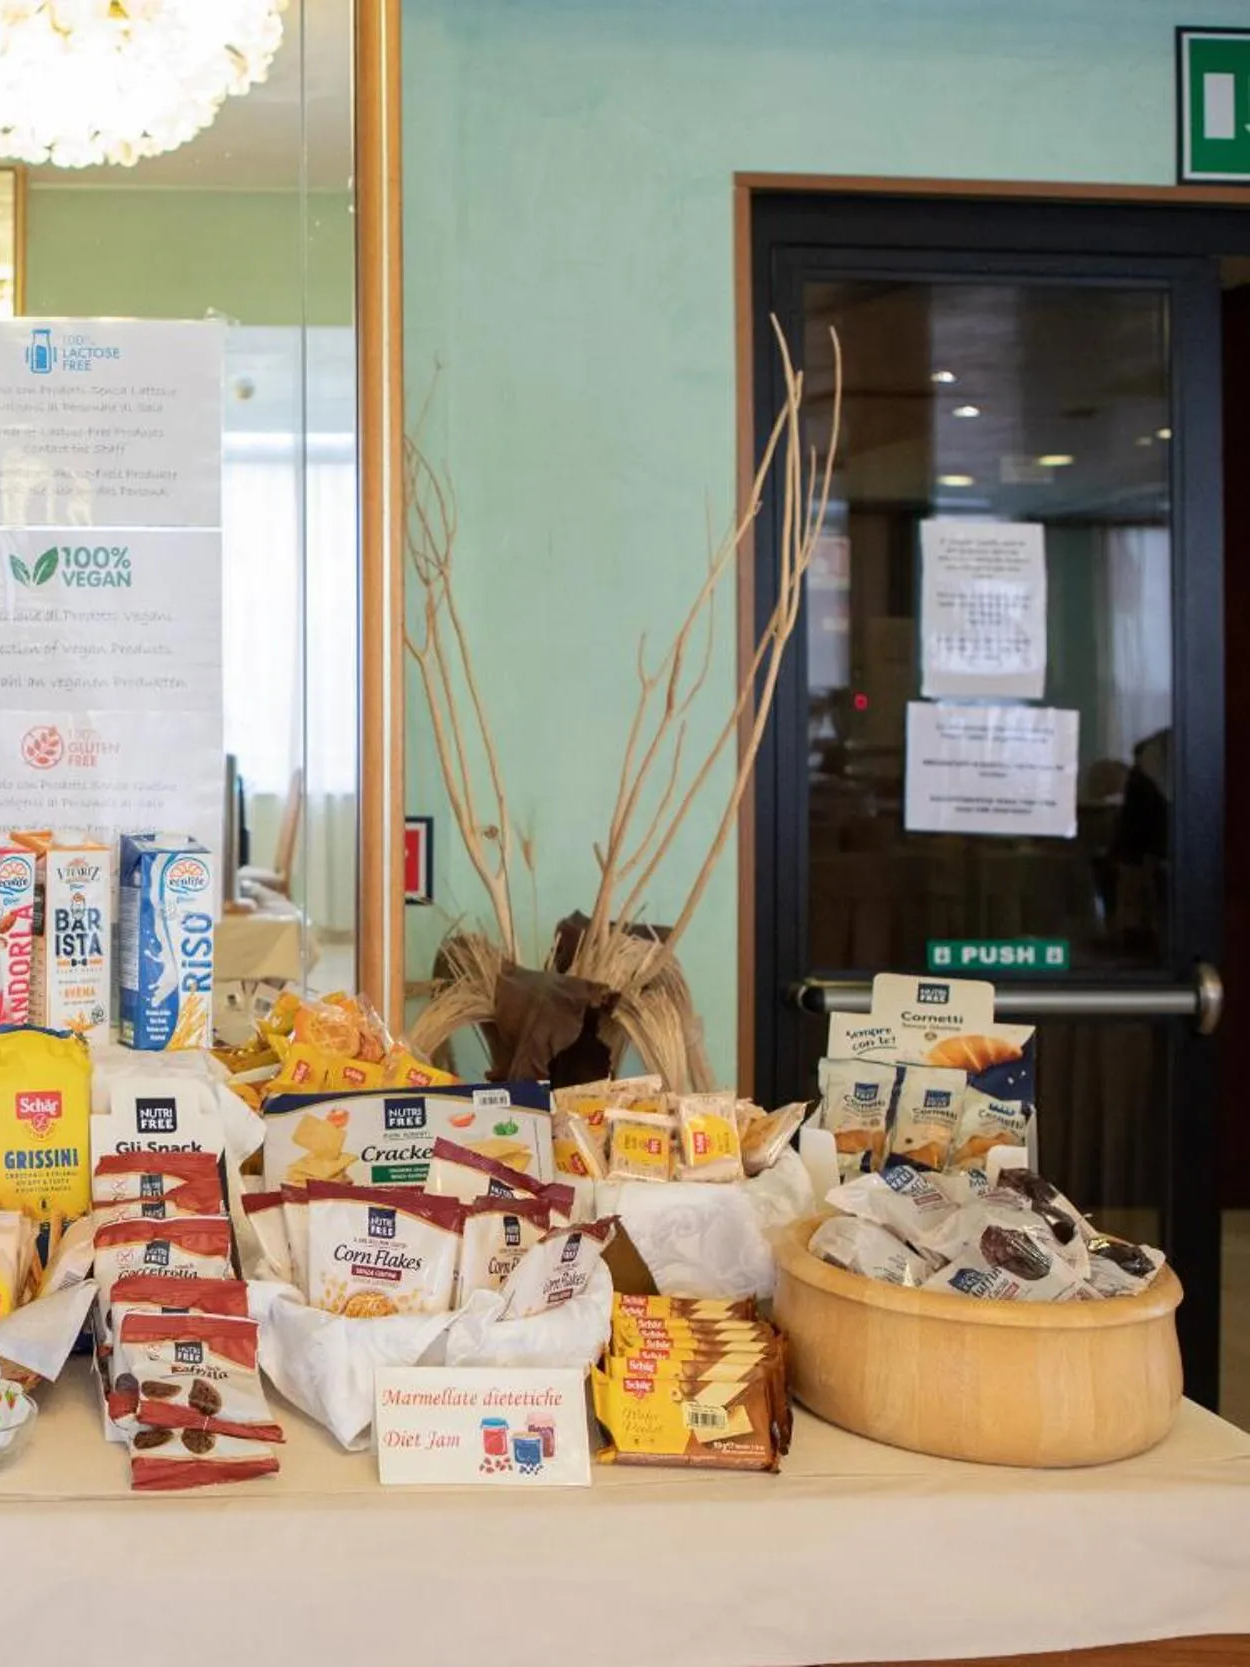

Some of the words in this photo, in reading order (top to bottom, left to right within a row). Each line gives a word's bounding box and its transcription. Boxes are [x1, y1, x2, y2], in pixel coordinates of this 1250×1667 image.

[62, 347, 121, 359] LACTOSE
[62, 360, 93, 372] FREE
[61, 546, 132, 569] 100%
[61, 570, 132, 587] VEGAN
[68, 741, 120, 754] GLUTEN
[68, 755, 98, 767] FREE
[169, 874, 205, 886] ecolife
[55, 933, 103, 957] ISTA
[961, 946, 1036, 965] PUSH
[901, 1010, 964, 1025] Cornetti
[20, 1097, 59, 1115] Schär
[388, 1107, 422, 1117] NUTRI
[140, 1108, 174, 1118] NUTRI
[141, 1119, 174, 1129] FREE
[389, 1117, 423, 1127] FREE
[116, 1141, 142, 1154] Gli
[147, 1141, 203, 1153] Snack
[361, 1145, 434, 1162] Cracke
[4, 1148, 79, 1169] GRISSINI
[370, 1226, 393, 1236] FREE
[146, 1254, 167, 1263] FREE
[334, 1244, 371, 1263] Corn
[375, 1249, 422, 1270] Flakes
[178, 1352, 201, 1362] FREE
[382, 1388, 478, 1407] Marmellate
[482, 1387, 563, 1406] dietetiche
[383, 1431, 421, 1448] Diet
[425, 1432, 461, 1450] Jam
